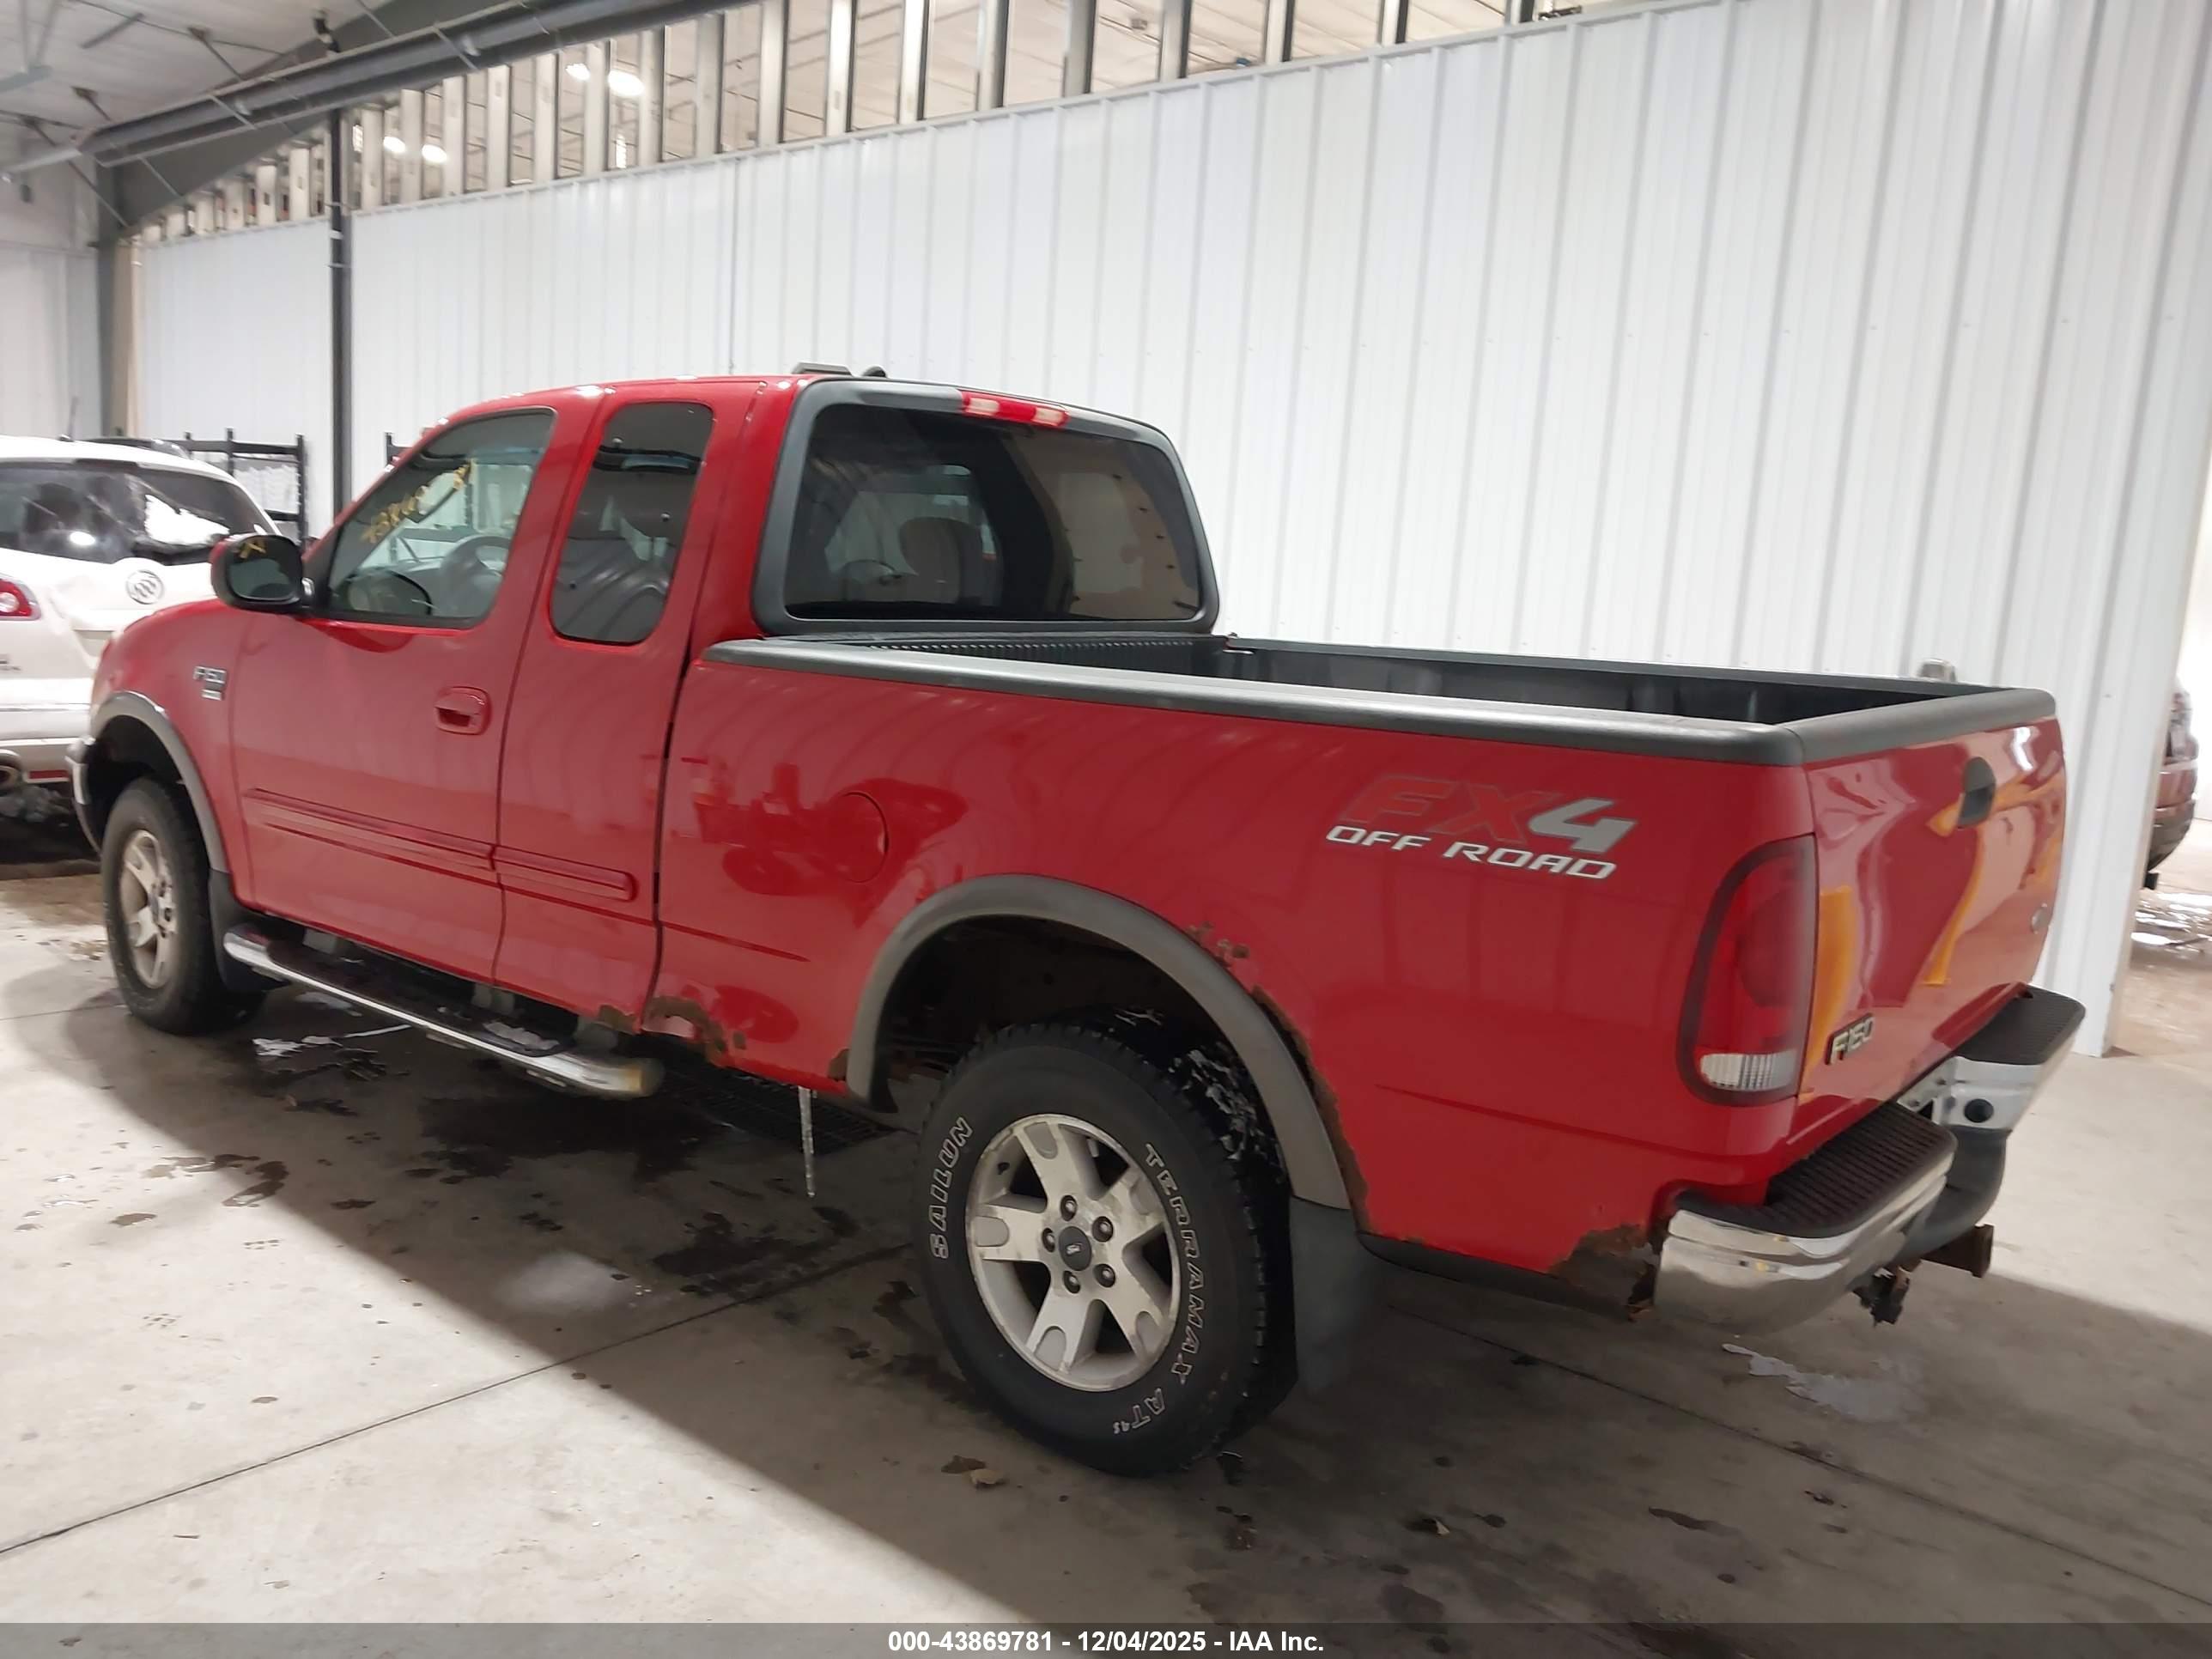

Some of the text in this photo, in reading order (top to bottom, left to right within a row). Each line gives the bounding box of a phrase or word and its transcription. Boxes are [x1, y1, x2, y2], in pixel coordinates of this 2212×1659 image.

[1325, 825, 1617, 880] OFF ROAD
[1337, 775, 1638, 855] FX4
[928, 1116, 974, 1260] SAILUN
[1146, 1143, 1204, 1385] TERRAMAX
